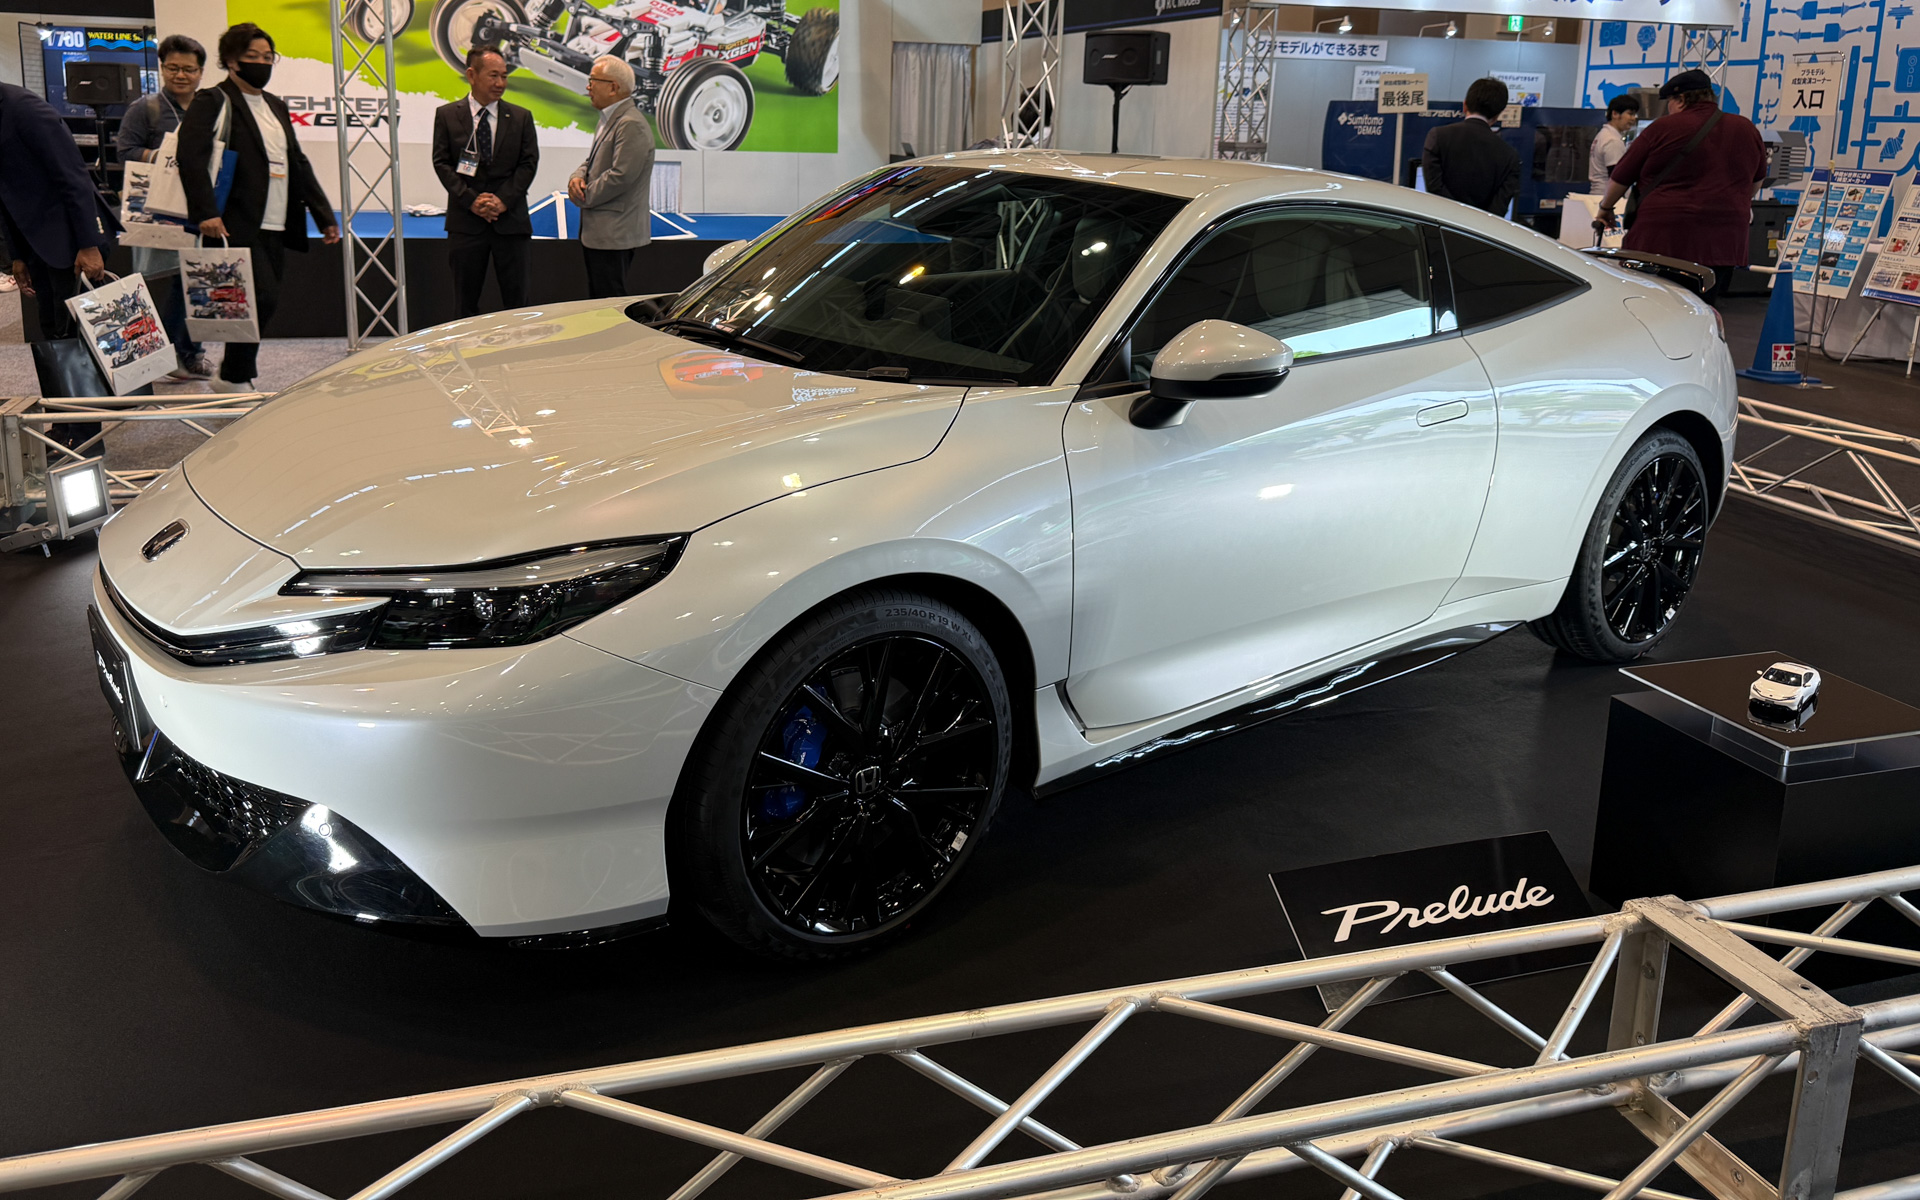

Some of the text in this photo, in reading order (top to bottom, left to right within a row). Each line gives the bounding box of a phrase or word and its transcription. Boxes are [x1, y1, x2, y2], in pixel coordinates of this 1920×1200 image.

[87, 31, 114, 40] WATER
[115, 32, 132, 41] LINE
[702, 40, 758, 60] NXGEN
[1257, 40, 1380, 57] プラモデルができるまで
[1801, 68, 1825, 76] プラモデル
[1382, 90, 1425, 107] 最後尾
[1792, 89, 1825, 109] 入口
[289, 112, 401, 127] XGEN
[1347, 113, 1384, 126] Sumitomo
[1357, 126, 1382, 135] DEMAG
[885, 607, 927, 619] 235/40
[928, 613, 936, 622] R
[937, 615, 949, 627] 19
[950, 621, 961, 633] W
[962, 629, 974, 644] XL
[1320, 877, 1555, 943] Prelude
